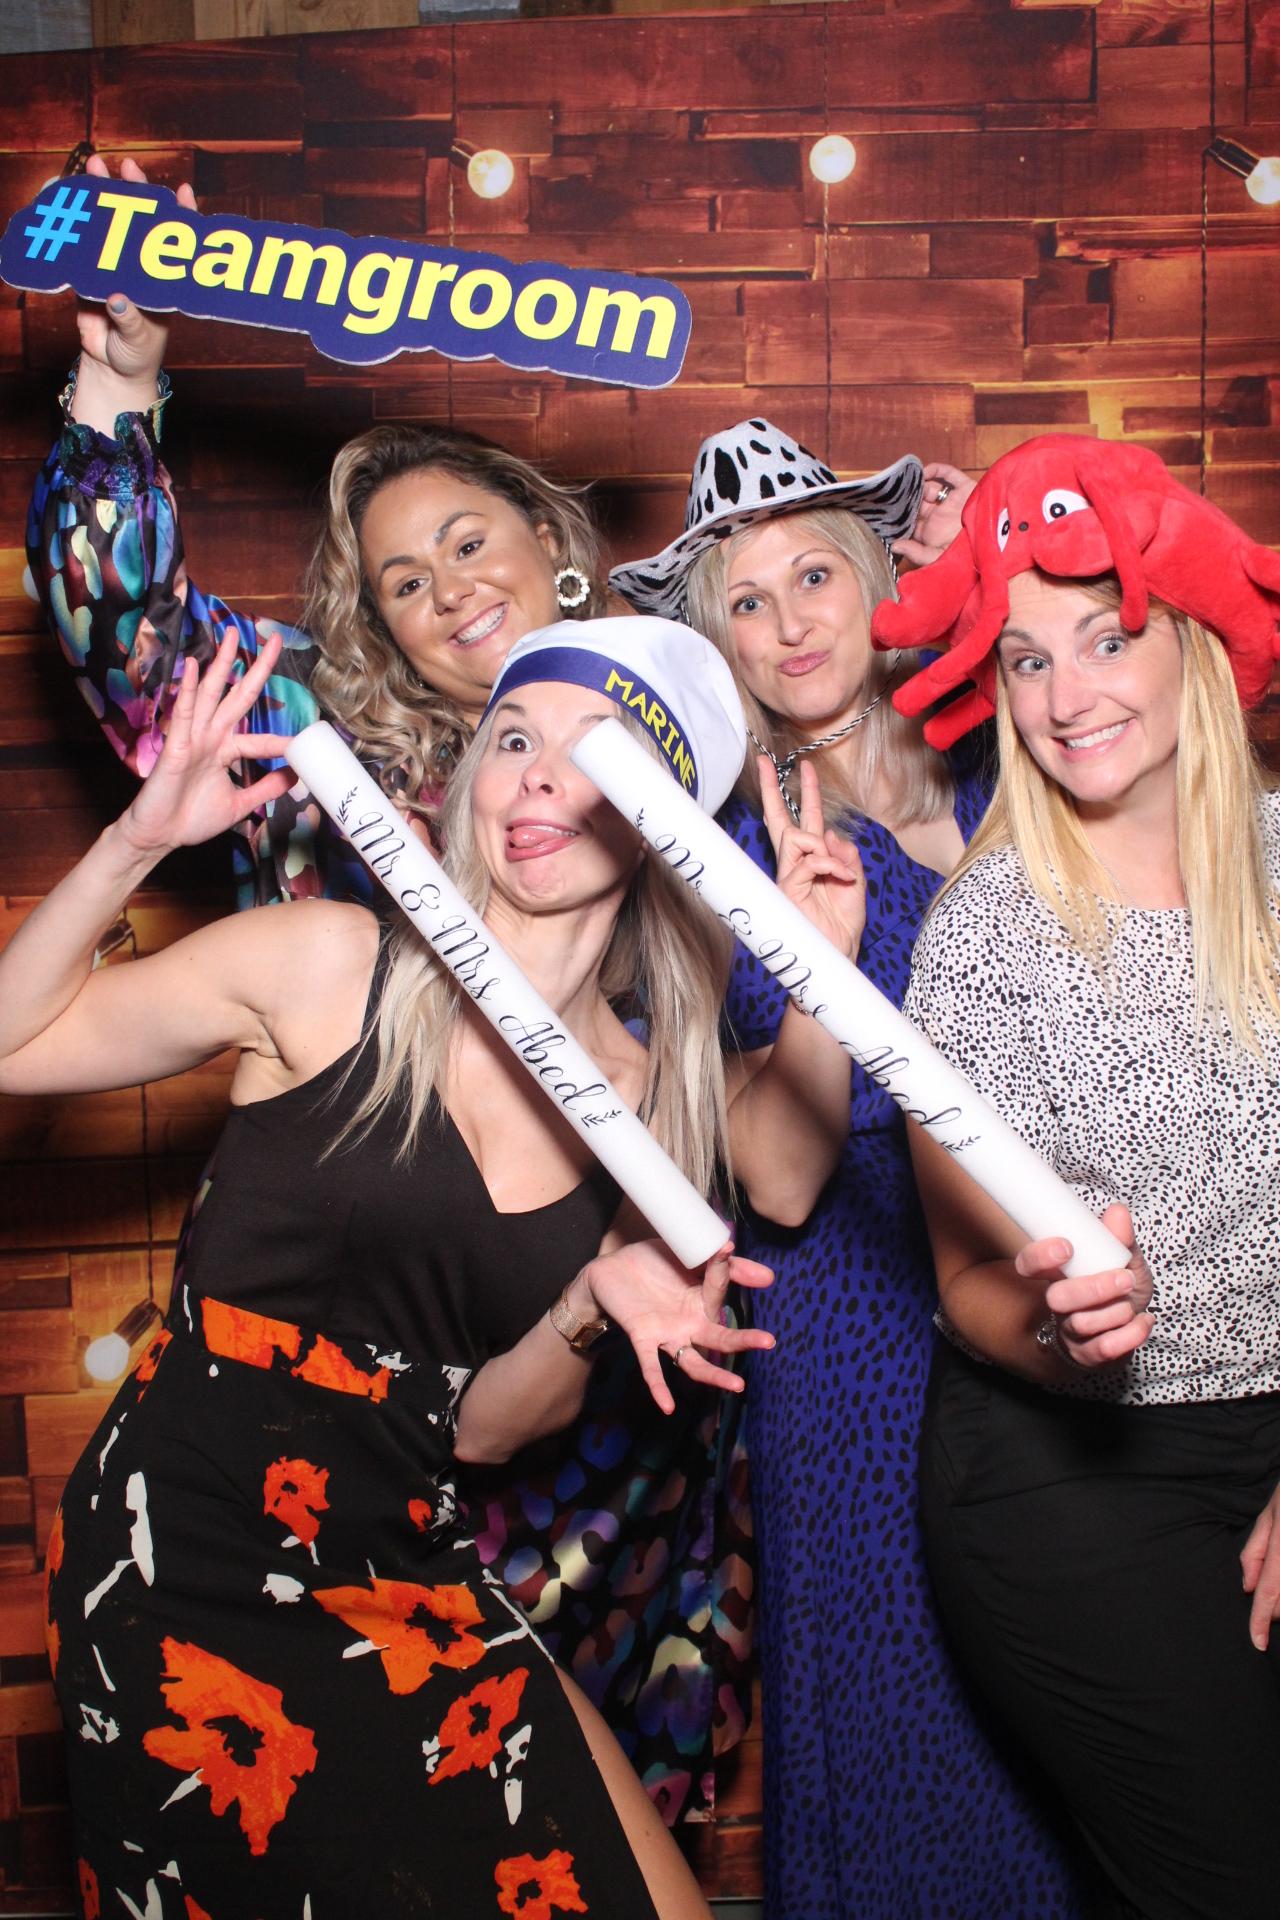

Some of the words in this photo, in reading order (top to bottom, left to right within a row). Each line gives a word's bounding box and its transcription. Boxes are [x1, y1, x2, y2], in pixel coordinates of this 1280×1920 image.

[24, 186, 678, 360] #Teamgroom
[604, 668, 696, 793] MARINE
[350, 811, 406, 886] Mr
[401, 883, 441, 912] &
[431, 914, 501, 1001] Mrs
[498, 1014, 607, 1111] Abed
